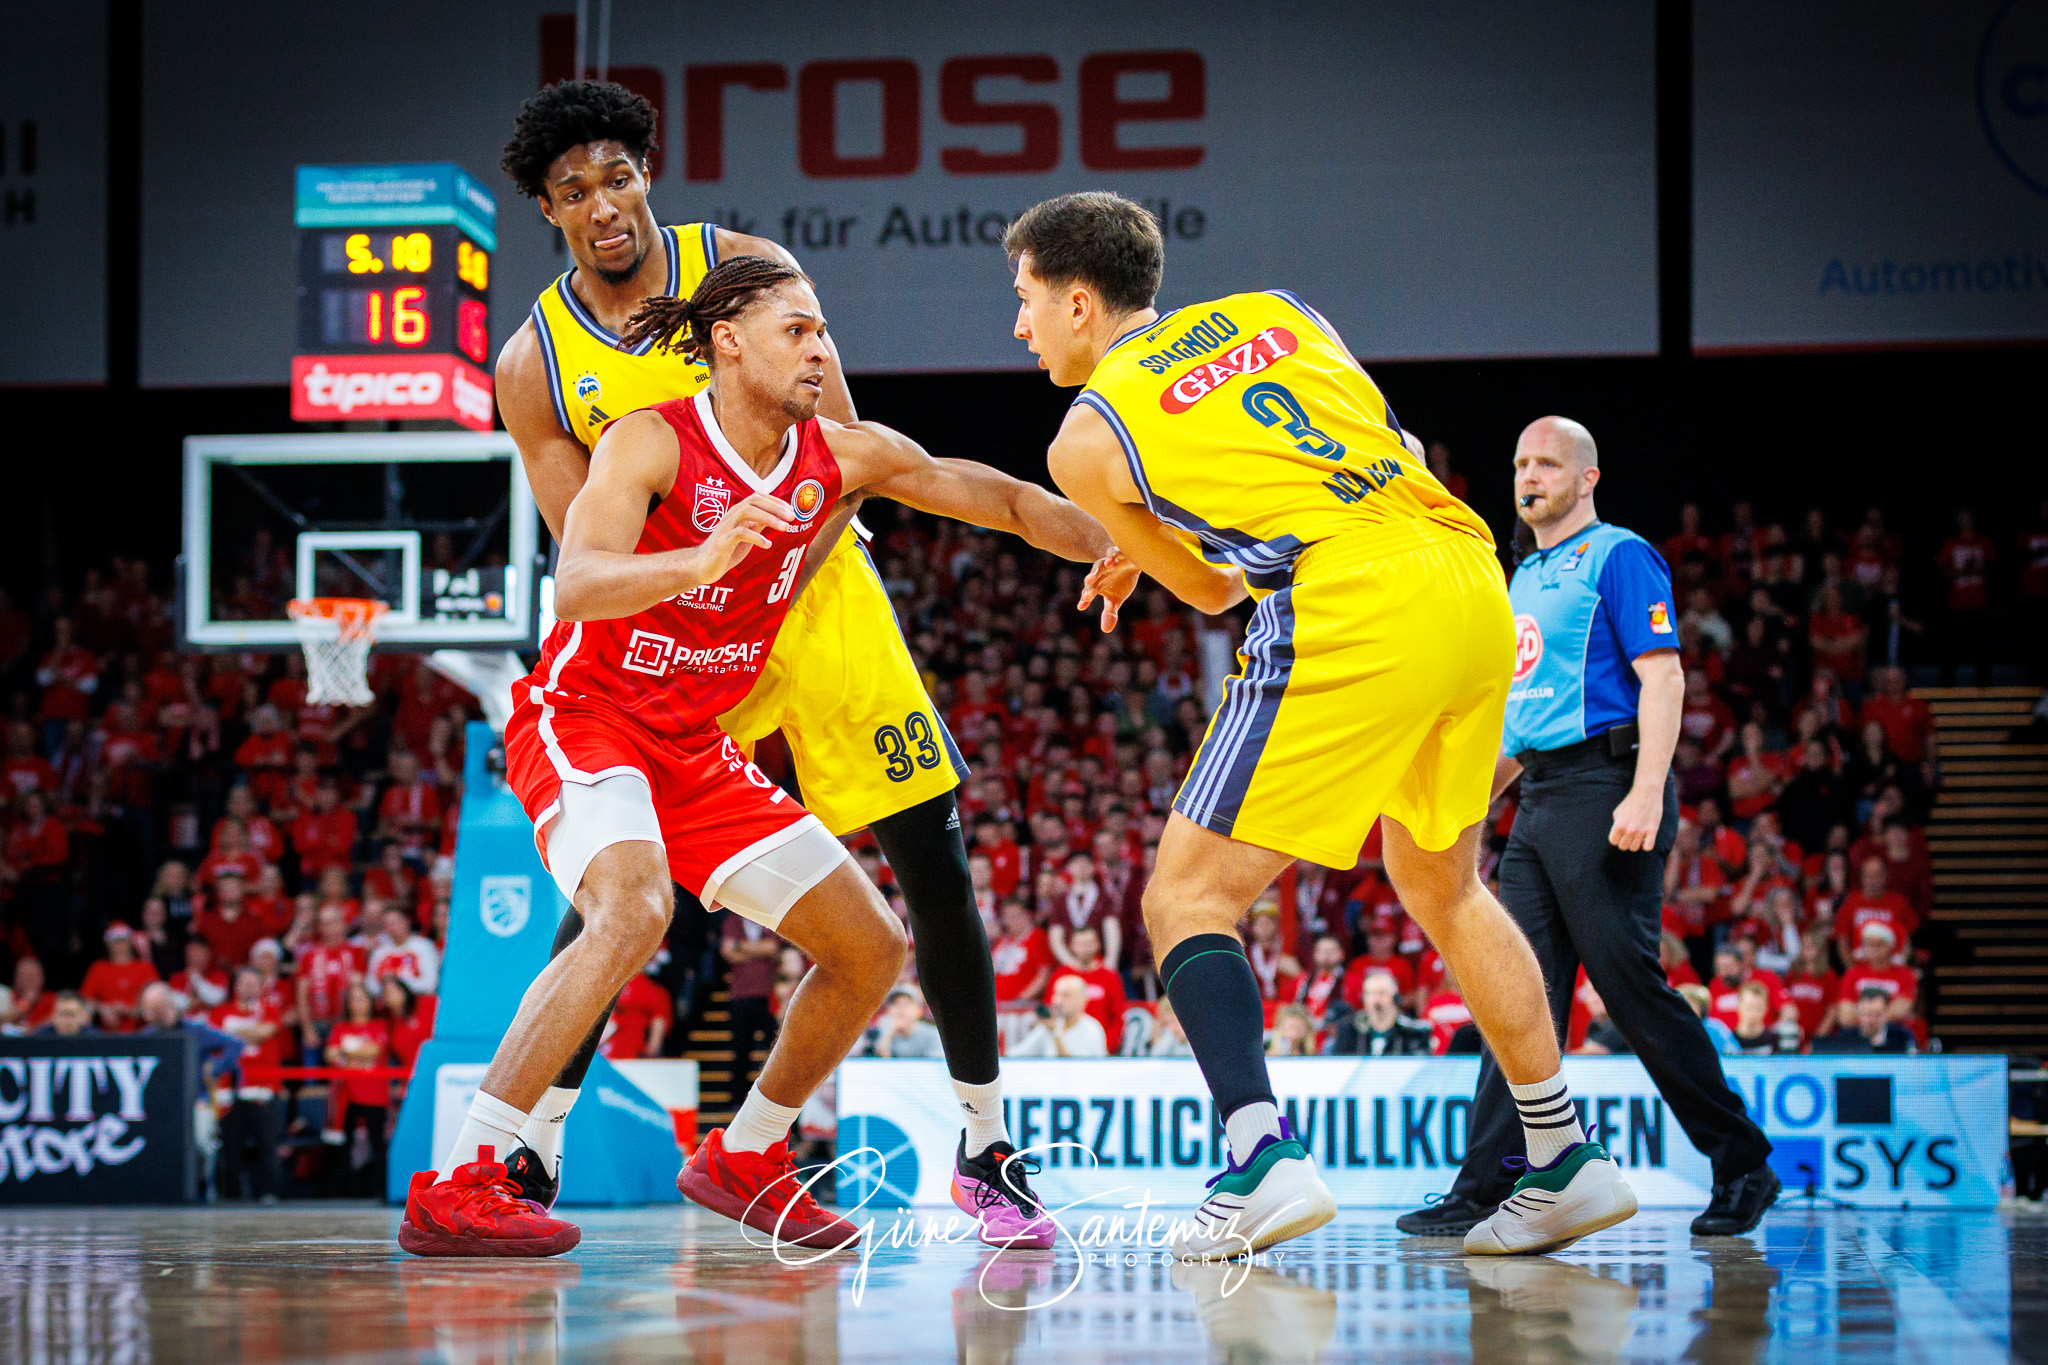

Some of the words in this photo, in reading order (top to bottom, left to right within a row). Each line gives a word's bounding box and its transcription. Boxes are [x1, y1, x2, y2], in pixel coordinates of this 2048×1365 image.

[877, 197, 1206, 248] Autole
[367, 286, 430, 348] 16
[1138, 311, 1239, 375] SPAGNOLO
[303, 362, 444, 414] tipico
[1241, 381, 1346, 461] 3
[677, 599, 724, 612] CONSULTING
[672, 639, 765, 666] PRIOSAF
[874, 711, 941, 783] 33
[0, 1055, 160, 1123] CITY
[0, 1112, 147, 1185] tore
[1003, 1098, 1231, 1167] ERZLIC
[1285, 1098, 1665, 1168] WILLKOEN
[1835, 1138, 1957, 1189] SYS
